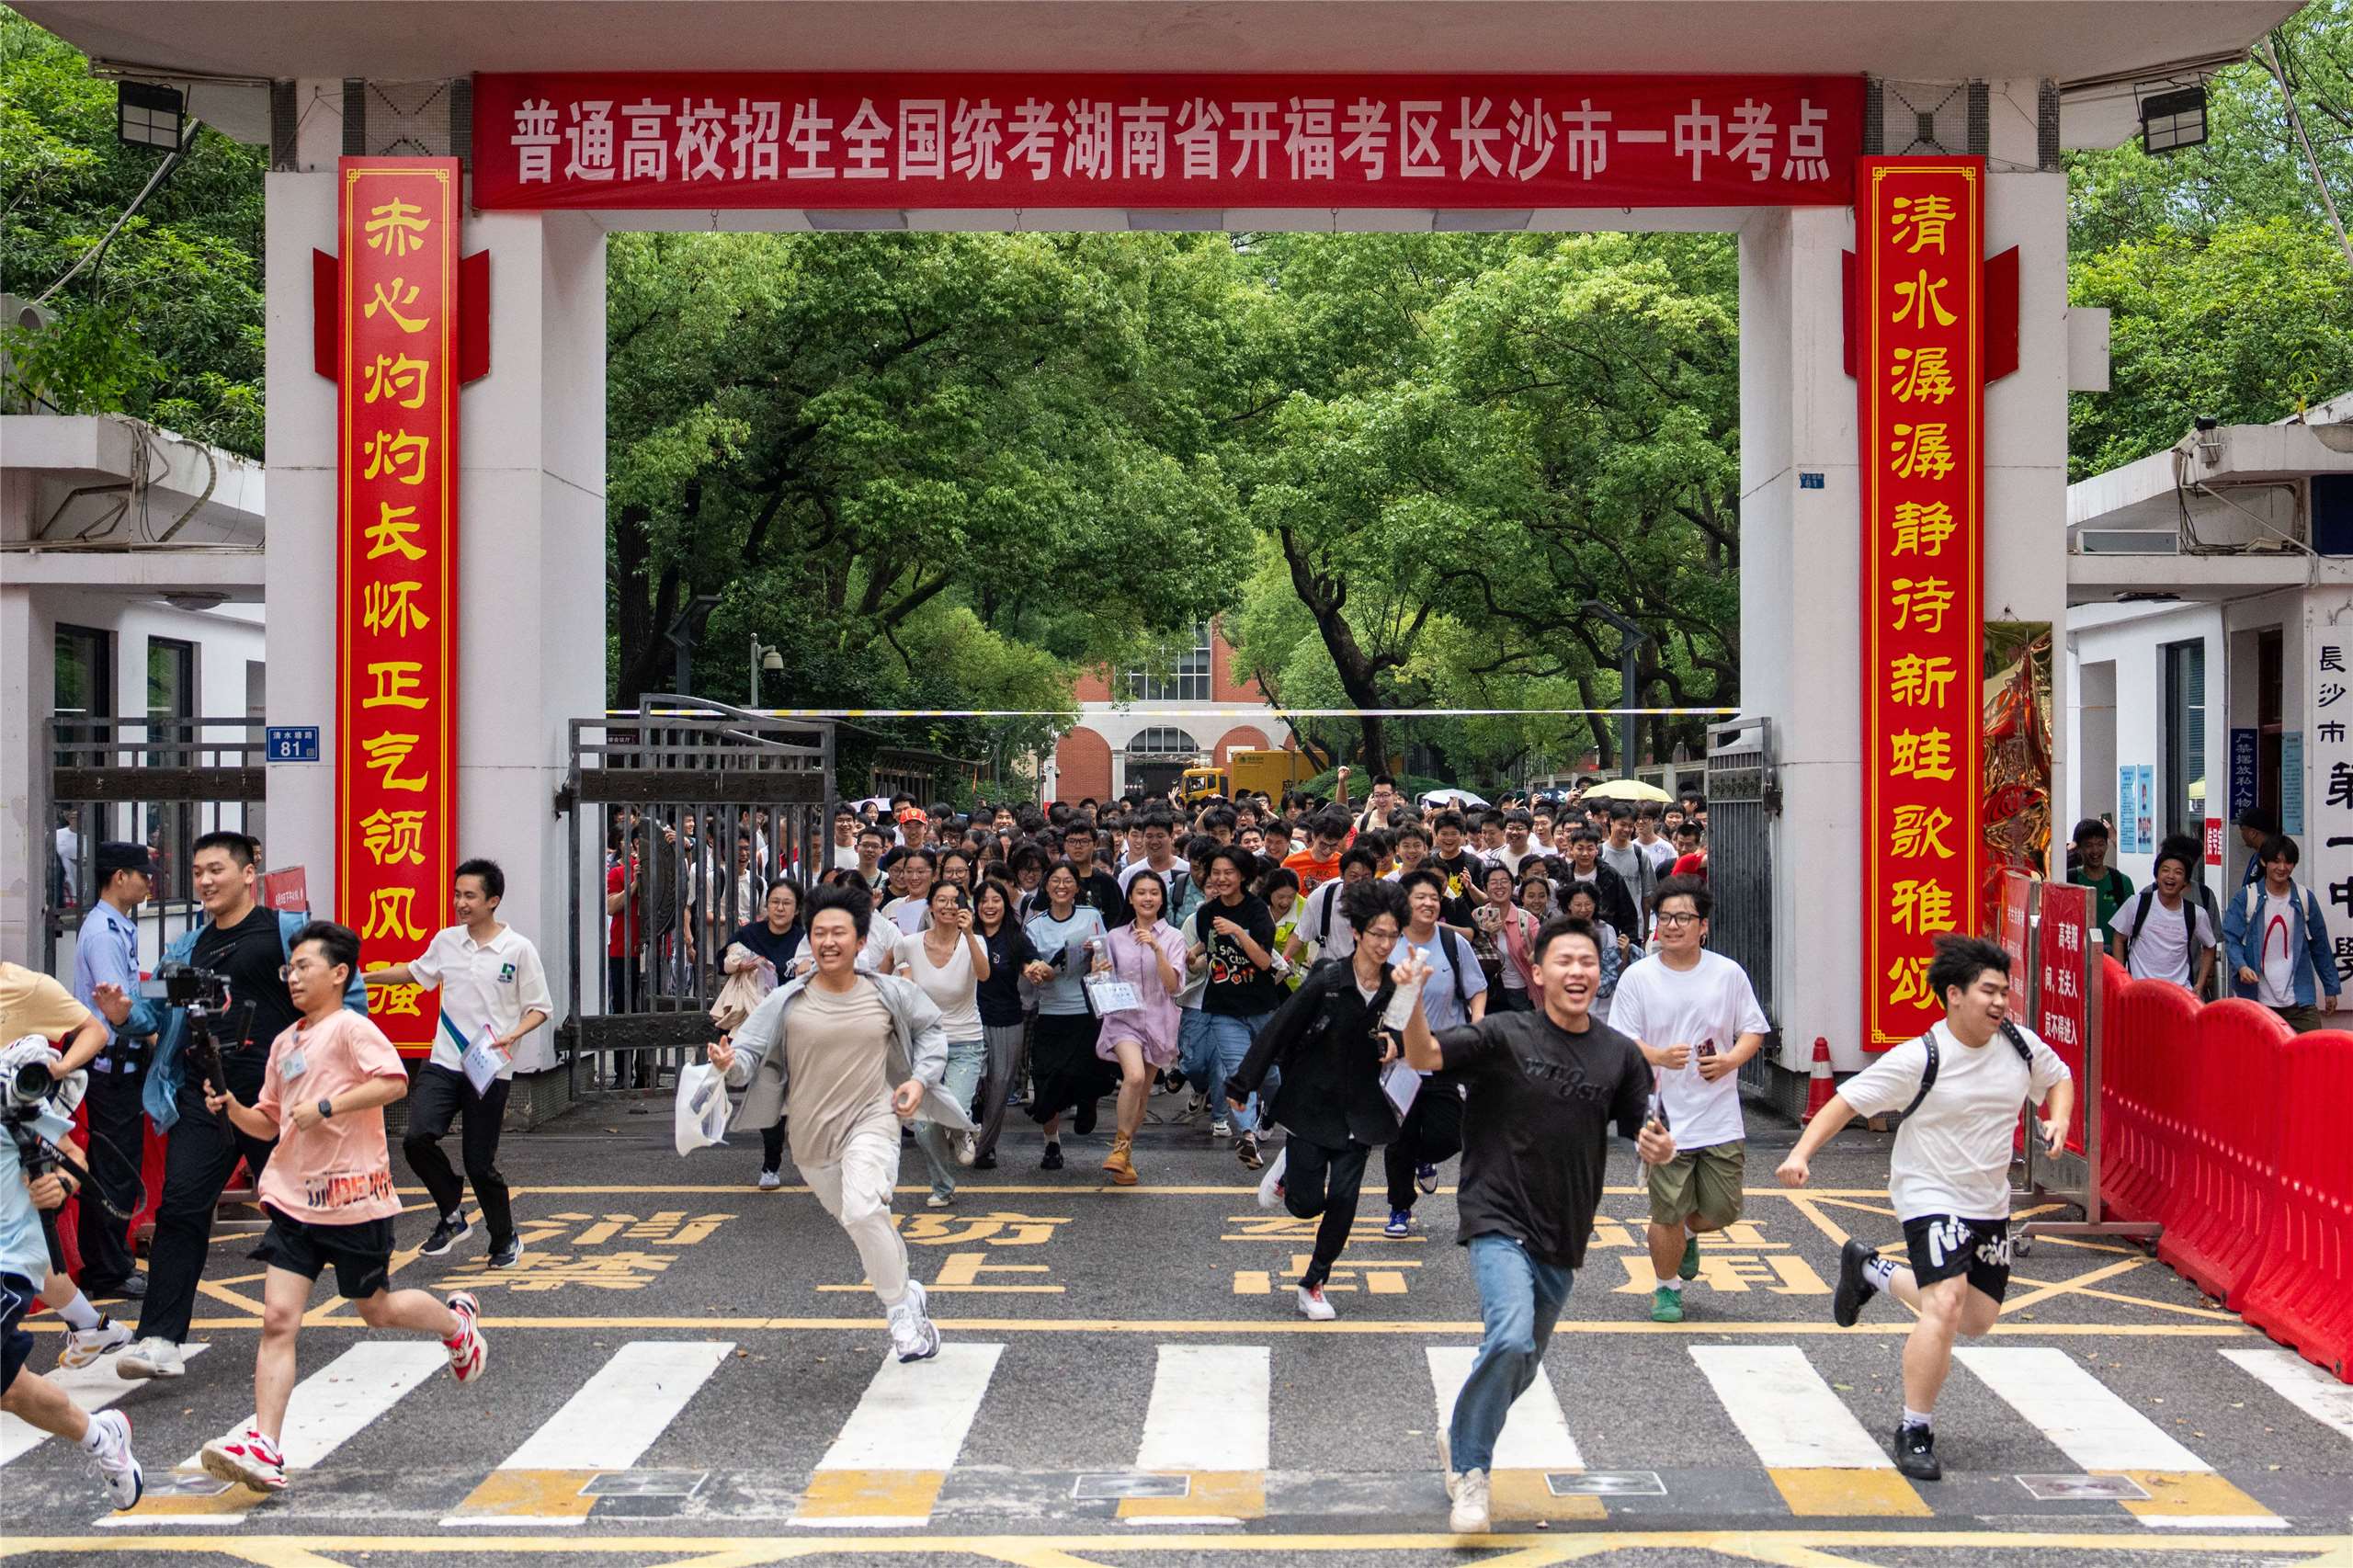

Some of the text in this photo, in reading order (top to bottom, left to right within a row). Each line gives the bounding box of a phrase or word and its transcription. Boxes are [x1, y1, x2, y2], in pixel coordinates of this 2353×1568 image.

[511, 96, 1830, 183] 普通高校招生全国统考湖南省开福考区长沙市一中考点
[1887, 194, 1958, 1010] 清水潺潺静待新蛙歌雅颂
[2317, 646, 2346, 743] 長沙市
[280, 741, 300, 757] 81
